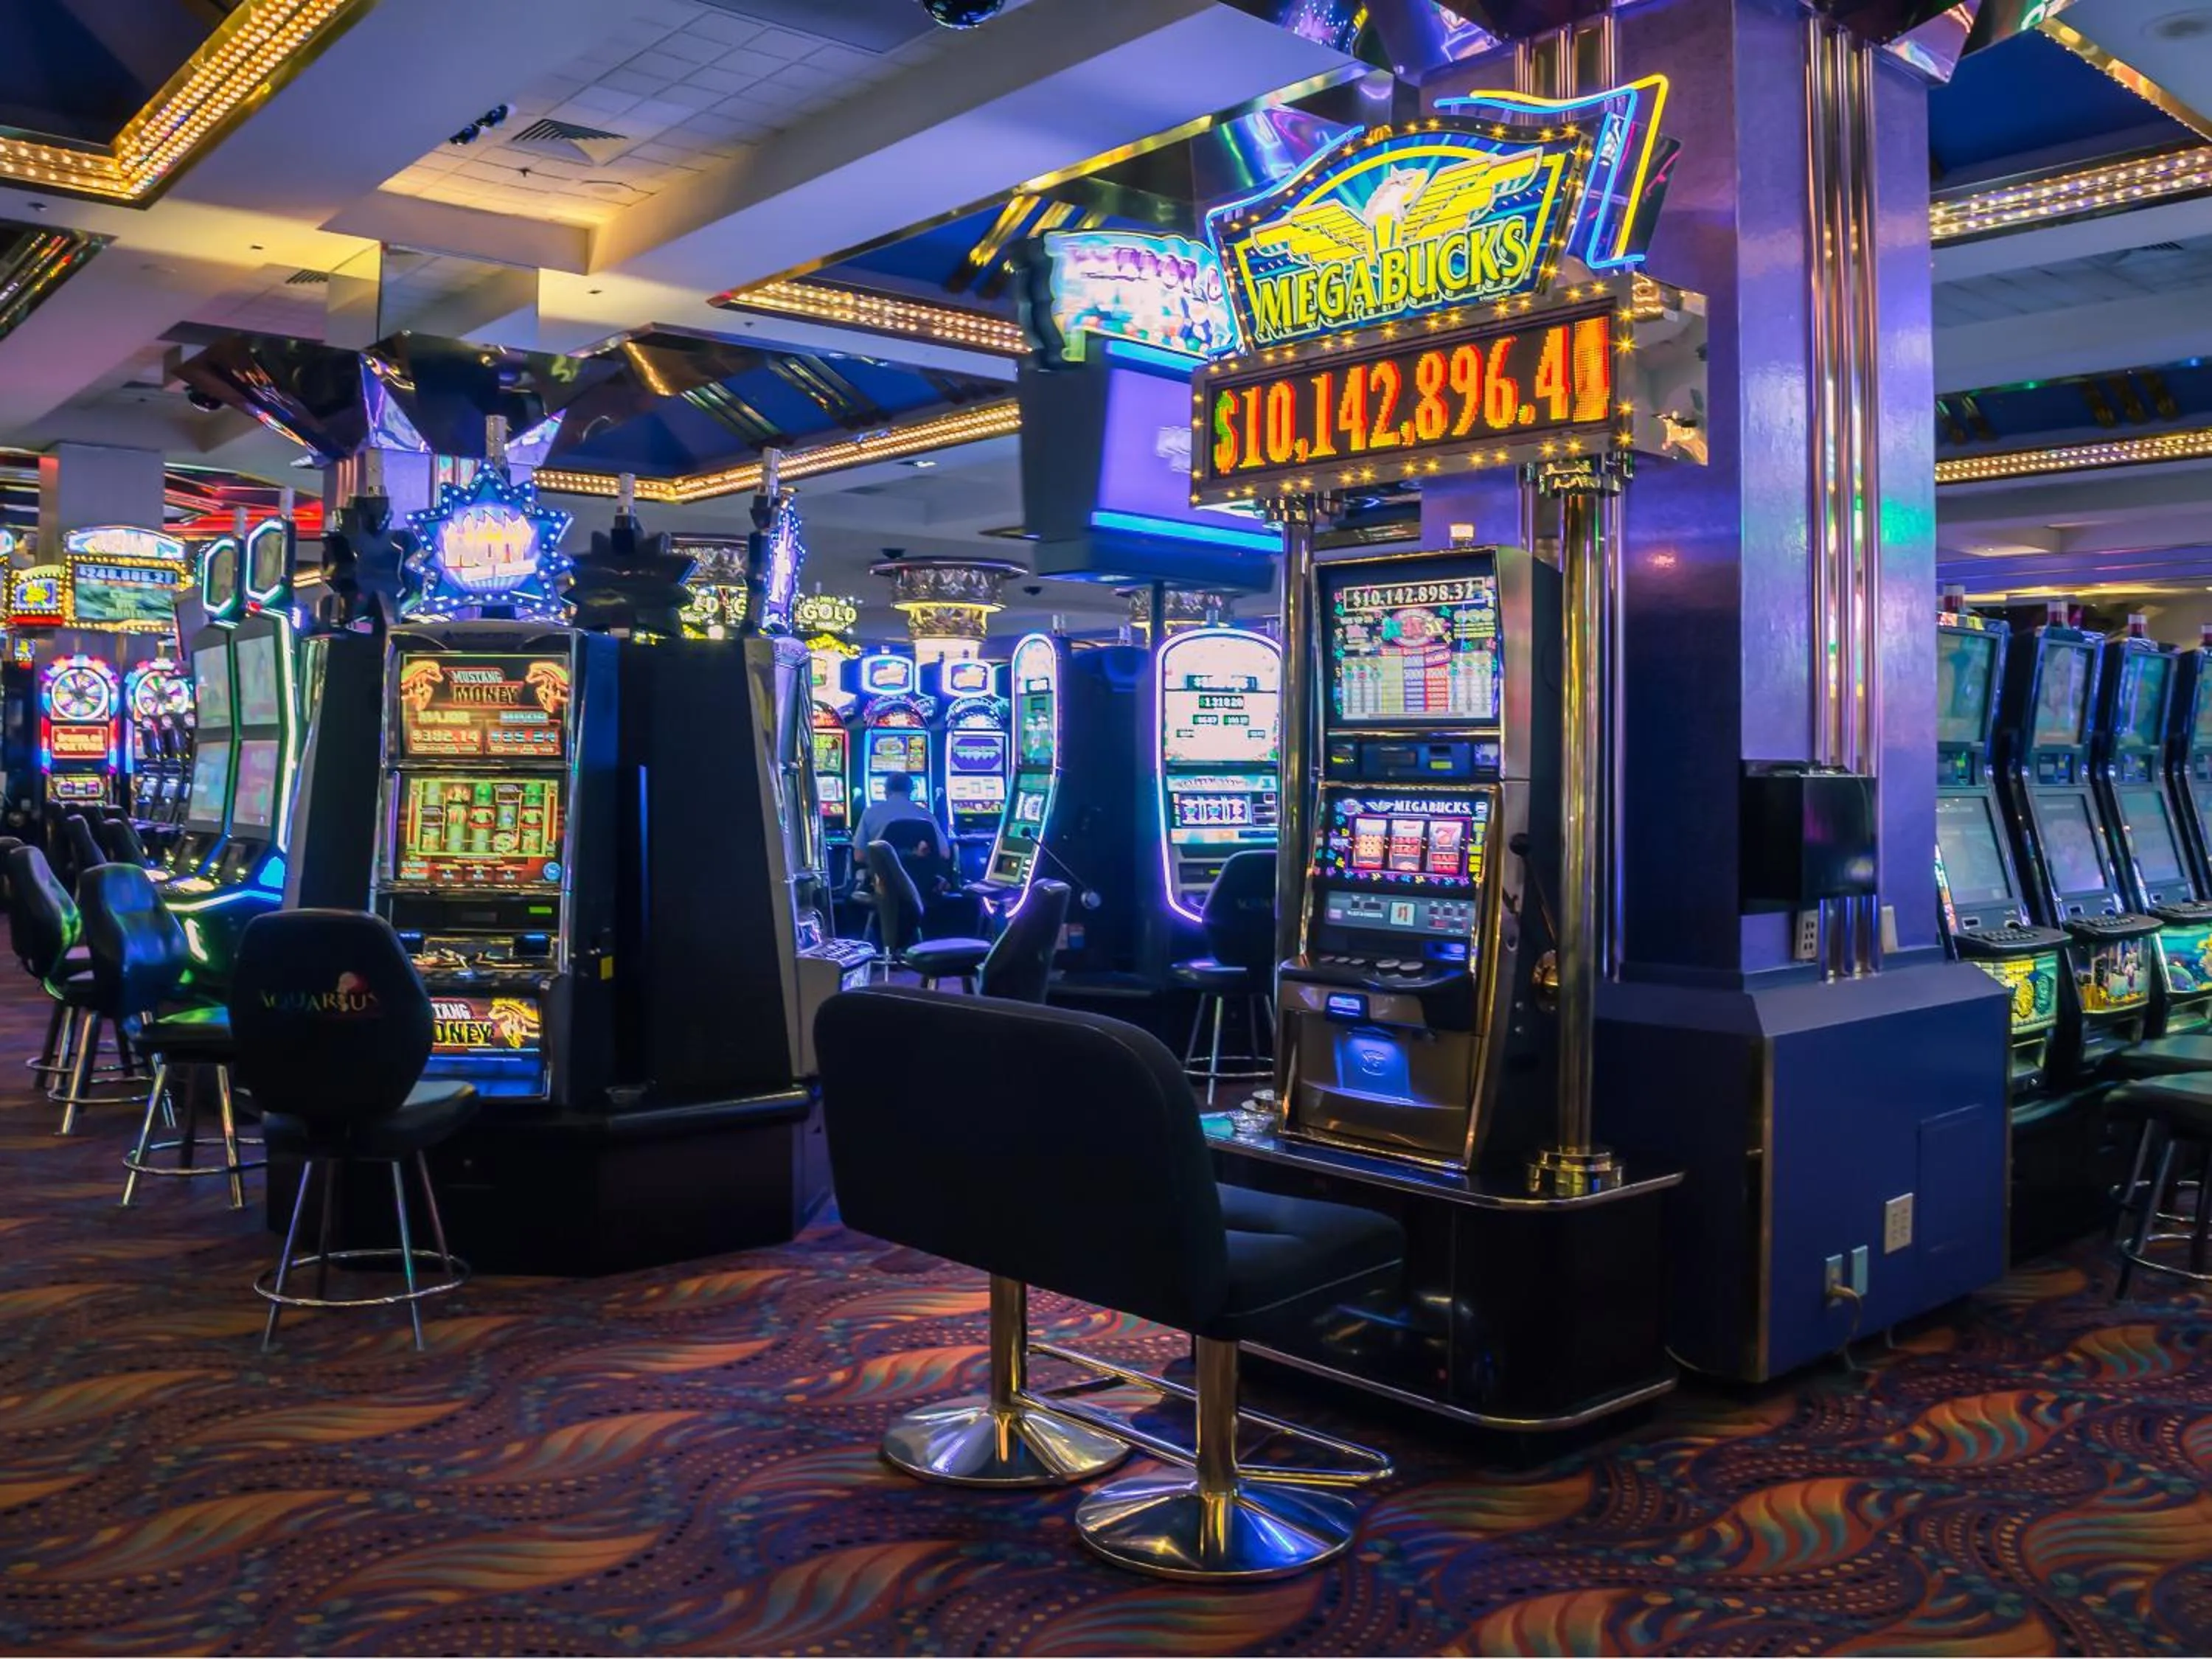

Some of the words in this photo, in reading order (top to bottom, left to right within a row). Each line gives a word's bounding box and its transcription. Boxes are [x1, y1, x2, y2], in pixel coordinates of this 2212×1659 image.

[1258, 218, 1529, 336] MEGABUCKS
[1214, 316, 1610, 476] $10,142,896.4
[802, 603, 857, 625] GOLD
[454, 685, 517, 703] MONEY
[1394, 799, 1470, 815] MEGABUCKS
[432, 1003, 470, 1020] TANG
